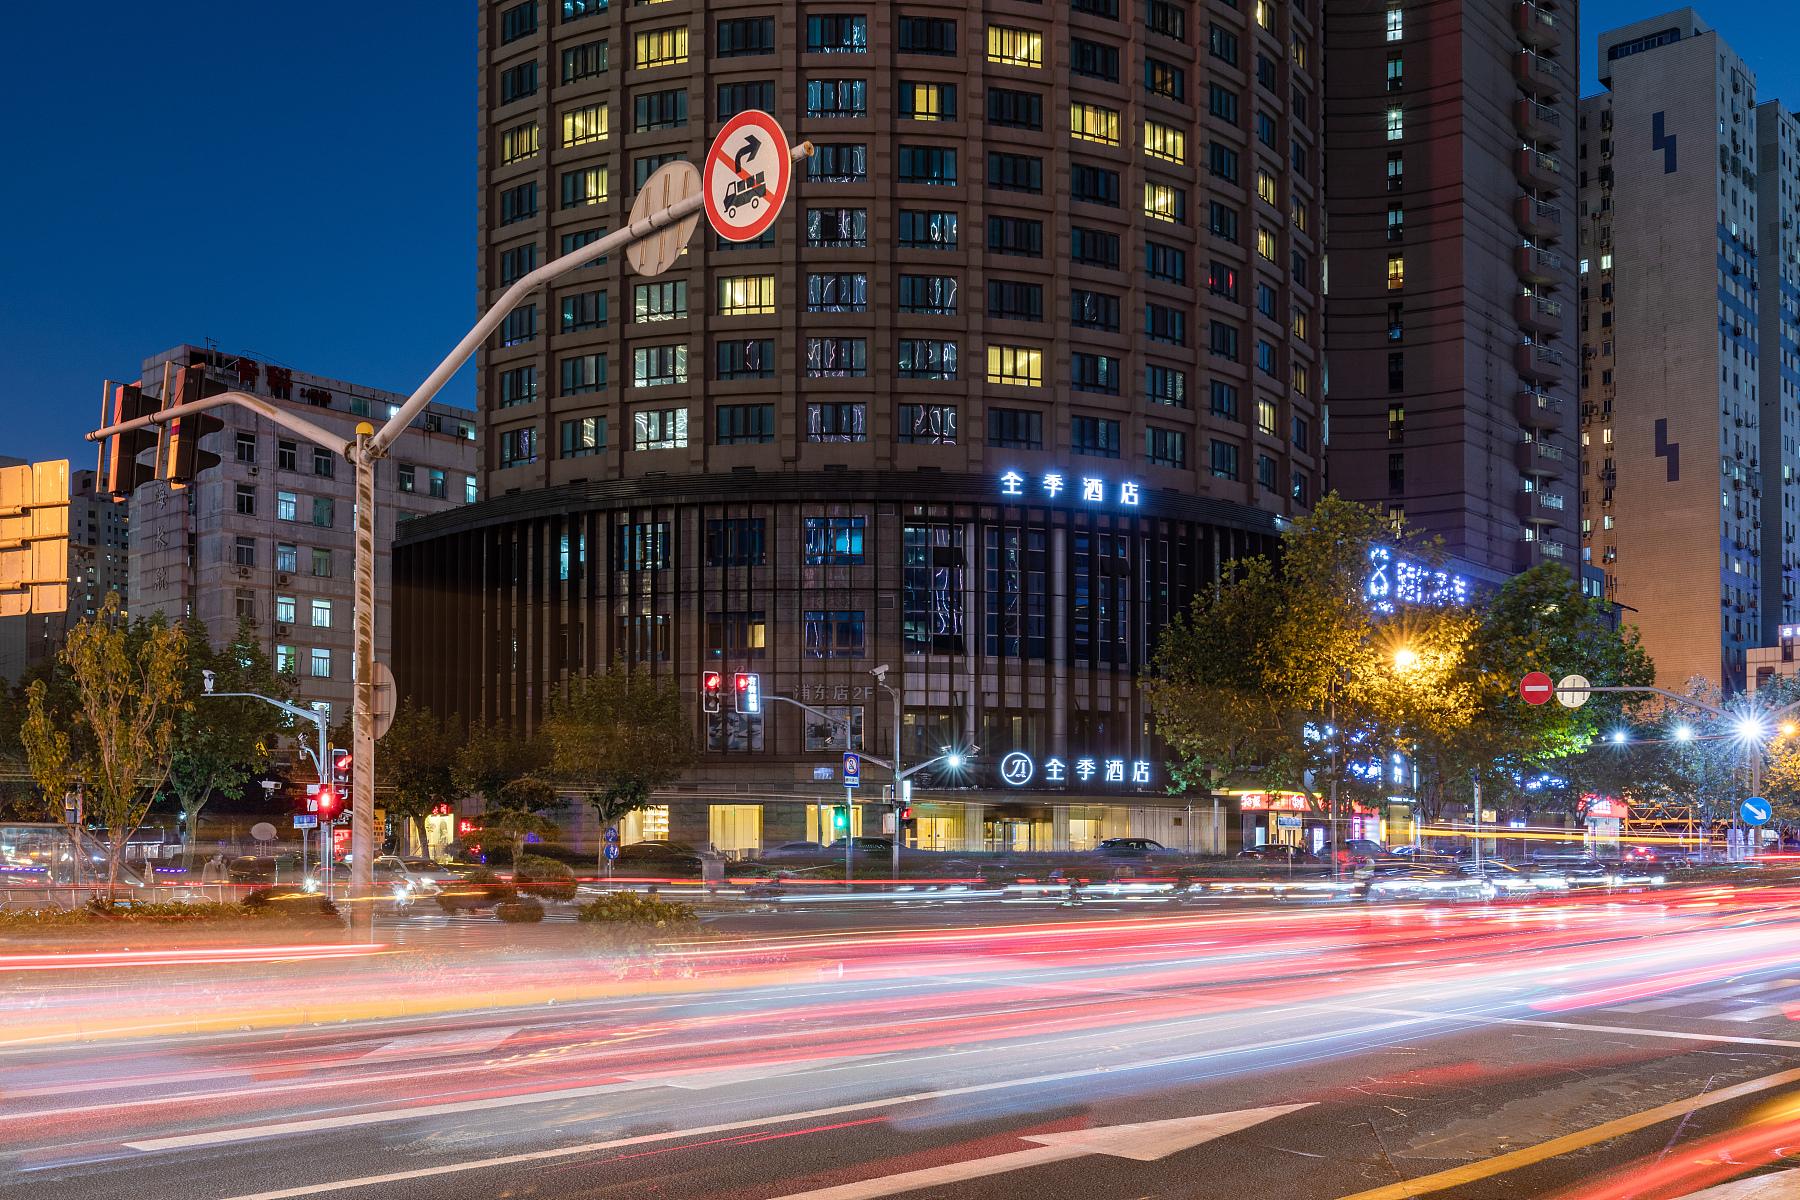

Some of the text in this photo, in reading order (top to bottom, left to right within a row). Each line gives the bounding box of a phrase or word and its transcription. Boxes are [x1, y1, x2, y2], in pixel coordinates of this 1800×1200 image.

[1000, 471, 1139, 505] 全季酒店
[1045, 759, 1150, 782] 全季酒店
